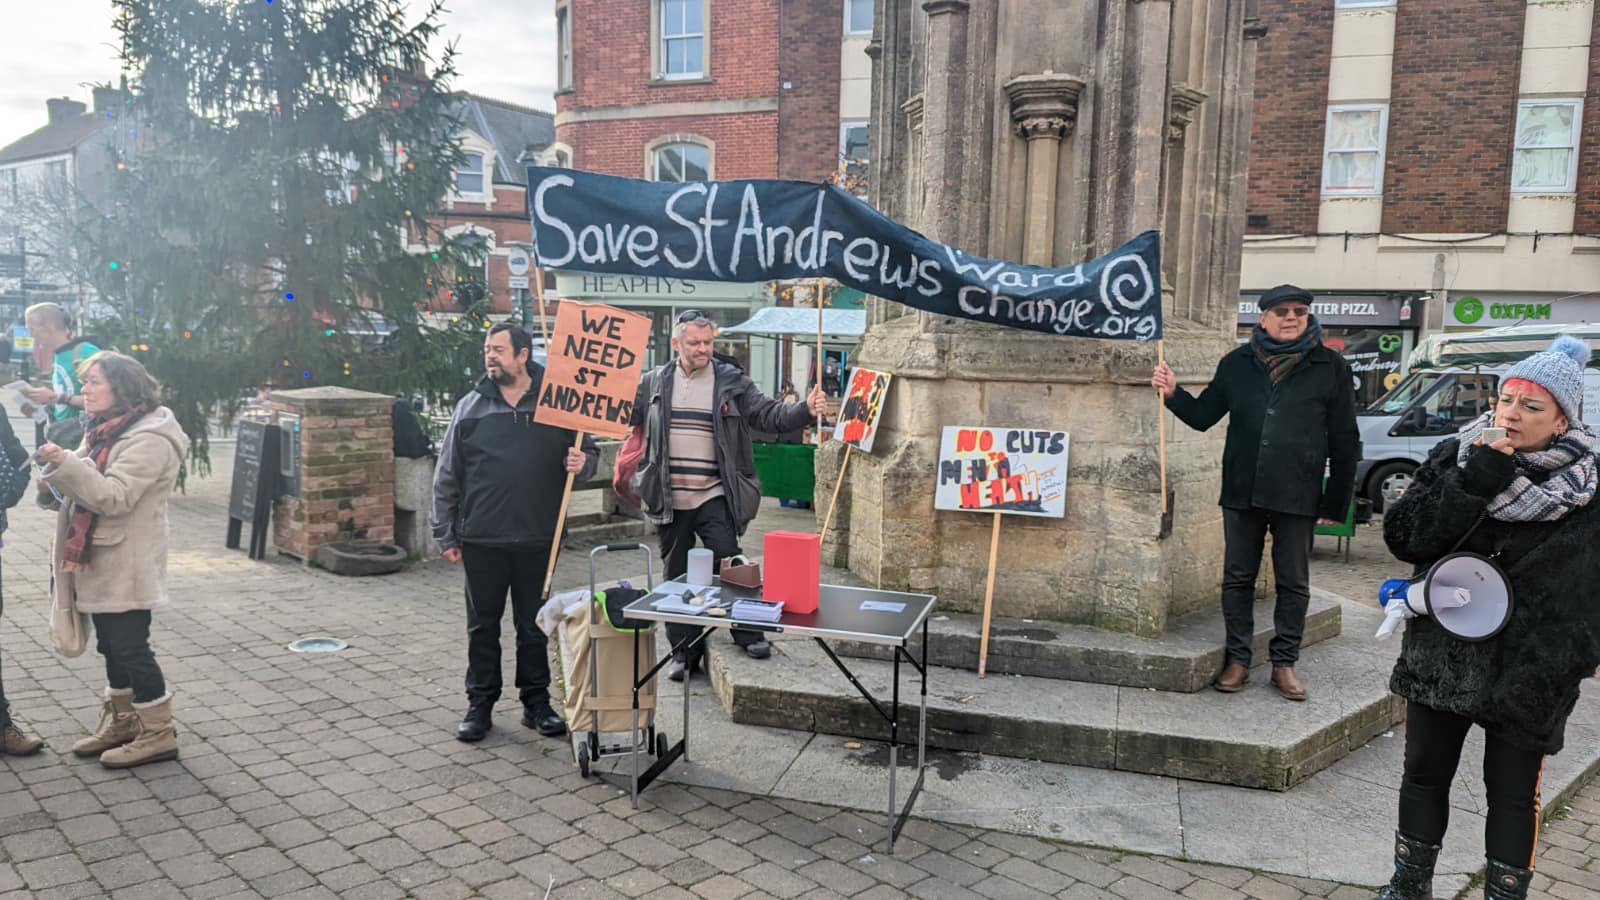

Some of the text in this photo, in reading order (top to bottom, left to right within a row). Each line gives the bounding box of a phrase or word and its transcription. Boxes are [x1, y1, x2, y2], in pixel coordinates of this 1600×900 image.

[534, 174, 660, 267] Save
[663, 182, 728, 278] St
[729, 183, 943, 296] Andrews
[944, 245, 1087, 288] Ward
[582, 275, 697, 294] HEAPHYS
[581, 309, 625, 340] WE
[957, 284, 1157, 340] change.org
[1310, 303, 1339, 315] TTER
[1341, 303, 1379, 315] PIZZA.
[1489, 302, 1552, 320] OXFAM
[563, 334, 636, 370] NEED
[574, 366, 607, 387] ST
[539, 382, 633, 425] ANDREWS
[956, 429, 1065, 454] NO CUTS
[960, 469, 1041, 509] HEALTH
